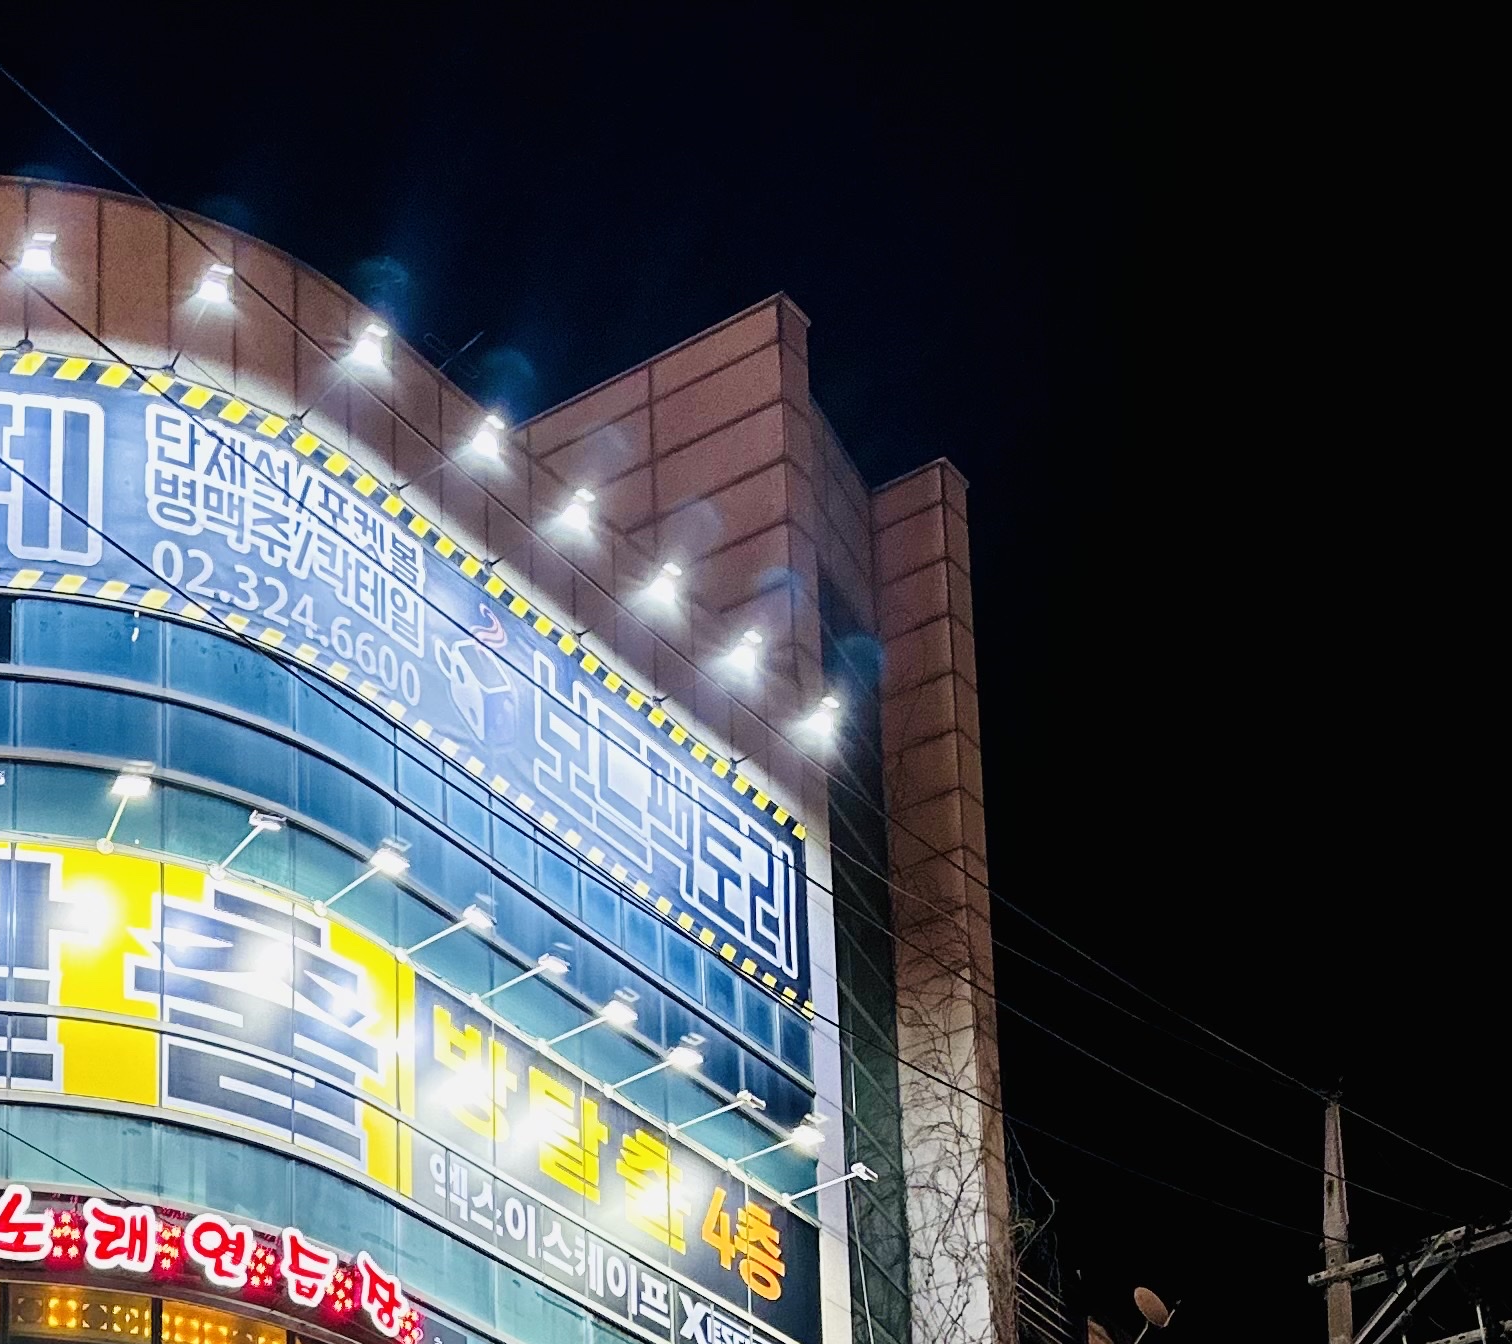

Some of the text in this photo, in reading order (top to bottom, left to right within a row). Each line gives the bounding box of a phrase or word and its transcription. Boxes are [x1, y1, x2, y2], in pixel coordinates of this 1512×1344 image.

[147, 466, 424, 657] 병맥주/칵테일
[152, 540, 421, 706] 02.324.6600
[534, 650, 798, 980] 보드팩토리
[433, 1004, 787, 1301] 방탈출 4층
